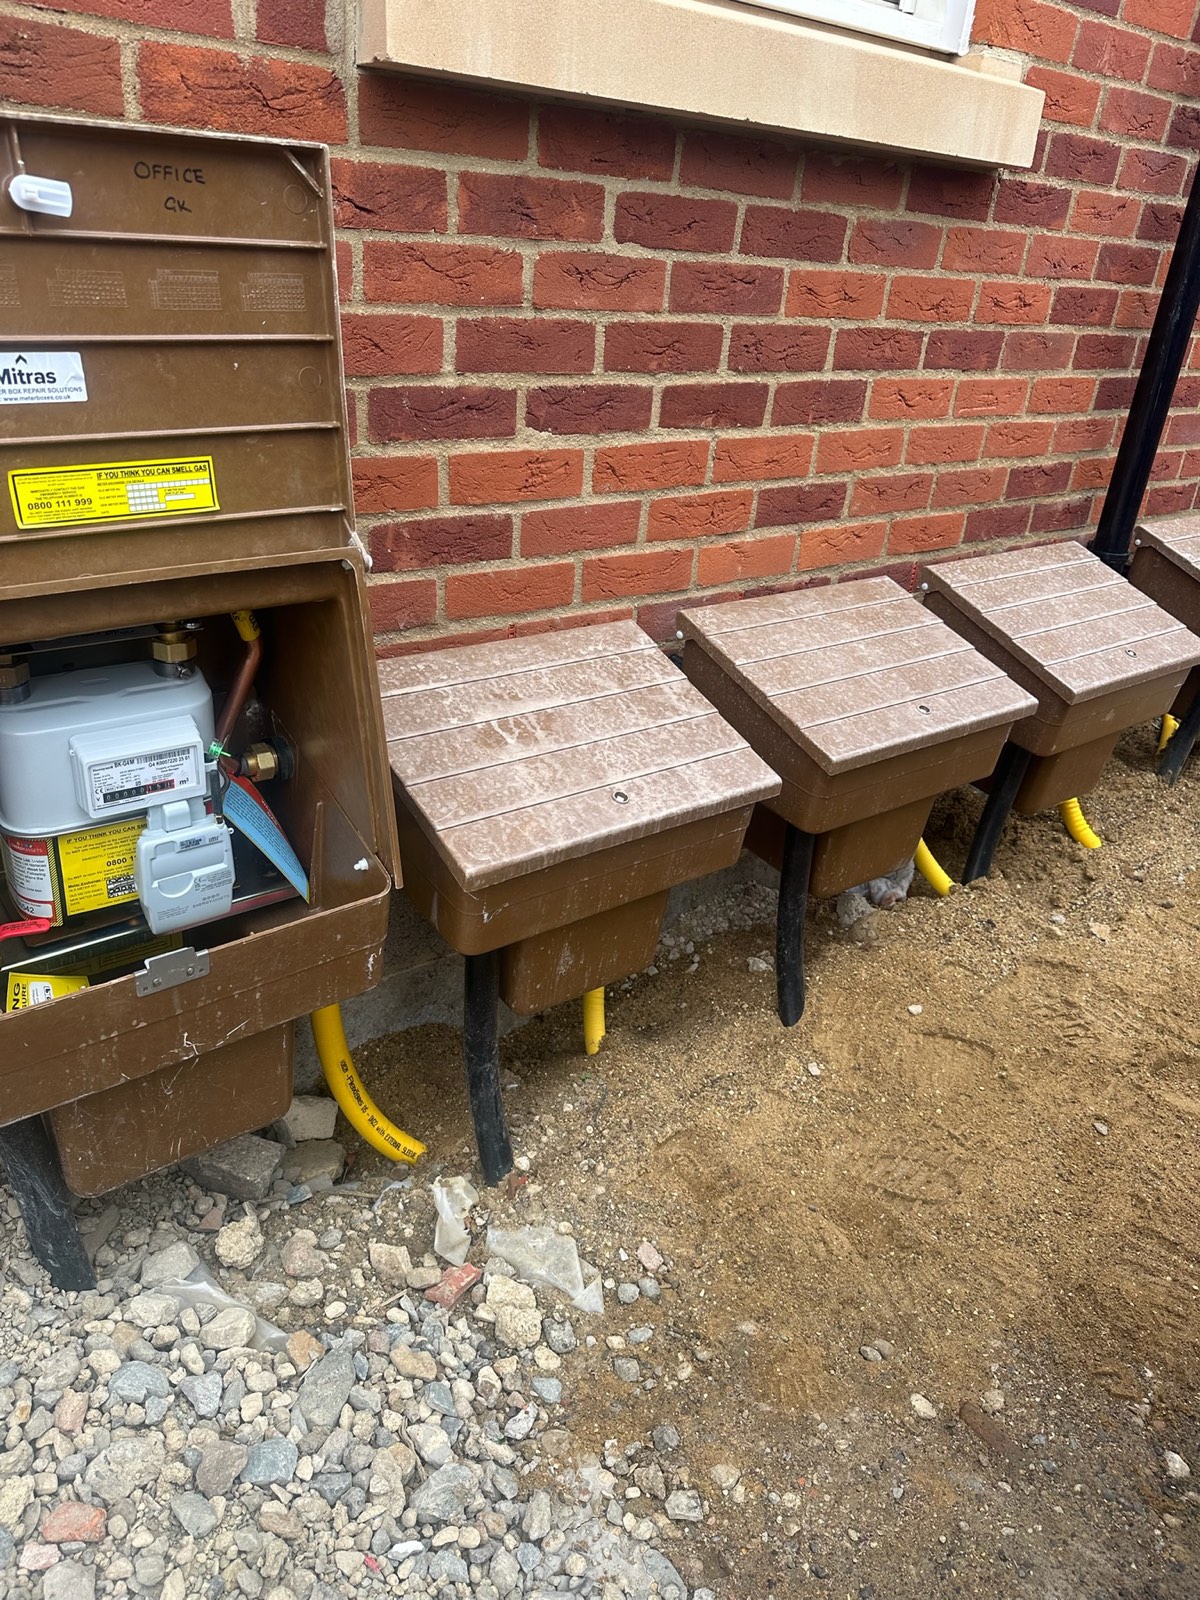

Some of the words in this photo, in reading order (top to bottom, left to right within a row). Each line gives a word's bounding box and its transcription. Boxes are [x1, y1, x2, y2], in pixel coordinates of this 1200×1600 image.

[134, 161, 206, 184] OFFICE
[0, 368, 57, 385] Mitras
[104, 471, 119, 479] YOU
[120, 470, 140, 478] THINK
[141, 468, 156, 476] YOU
[194, 464, 207, 472] GAS
[28, 501, 52, 510] 0800
[56, 500, 71, 508] 111
[75, 498, 93, 506] 999
[107, 857, 127, 867] 0800
[376, 1127, 385, 1137] with
[384, 1134, 402, 1151] EXTERNAL
[402, 1147, 417, 1160] SLEEVE
